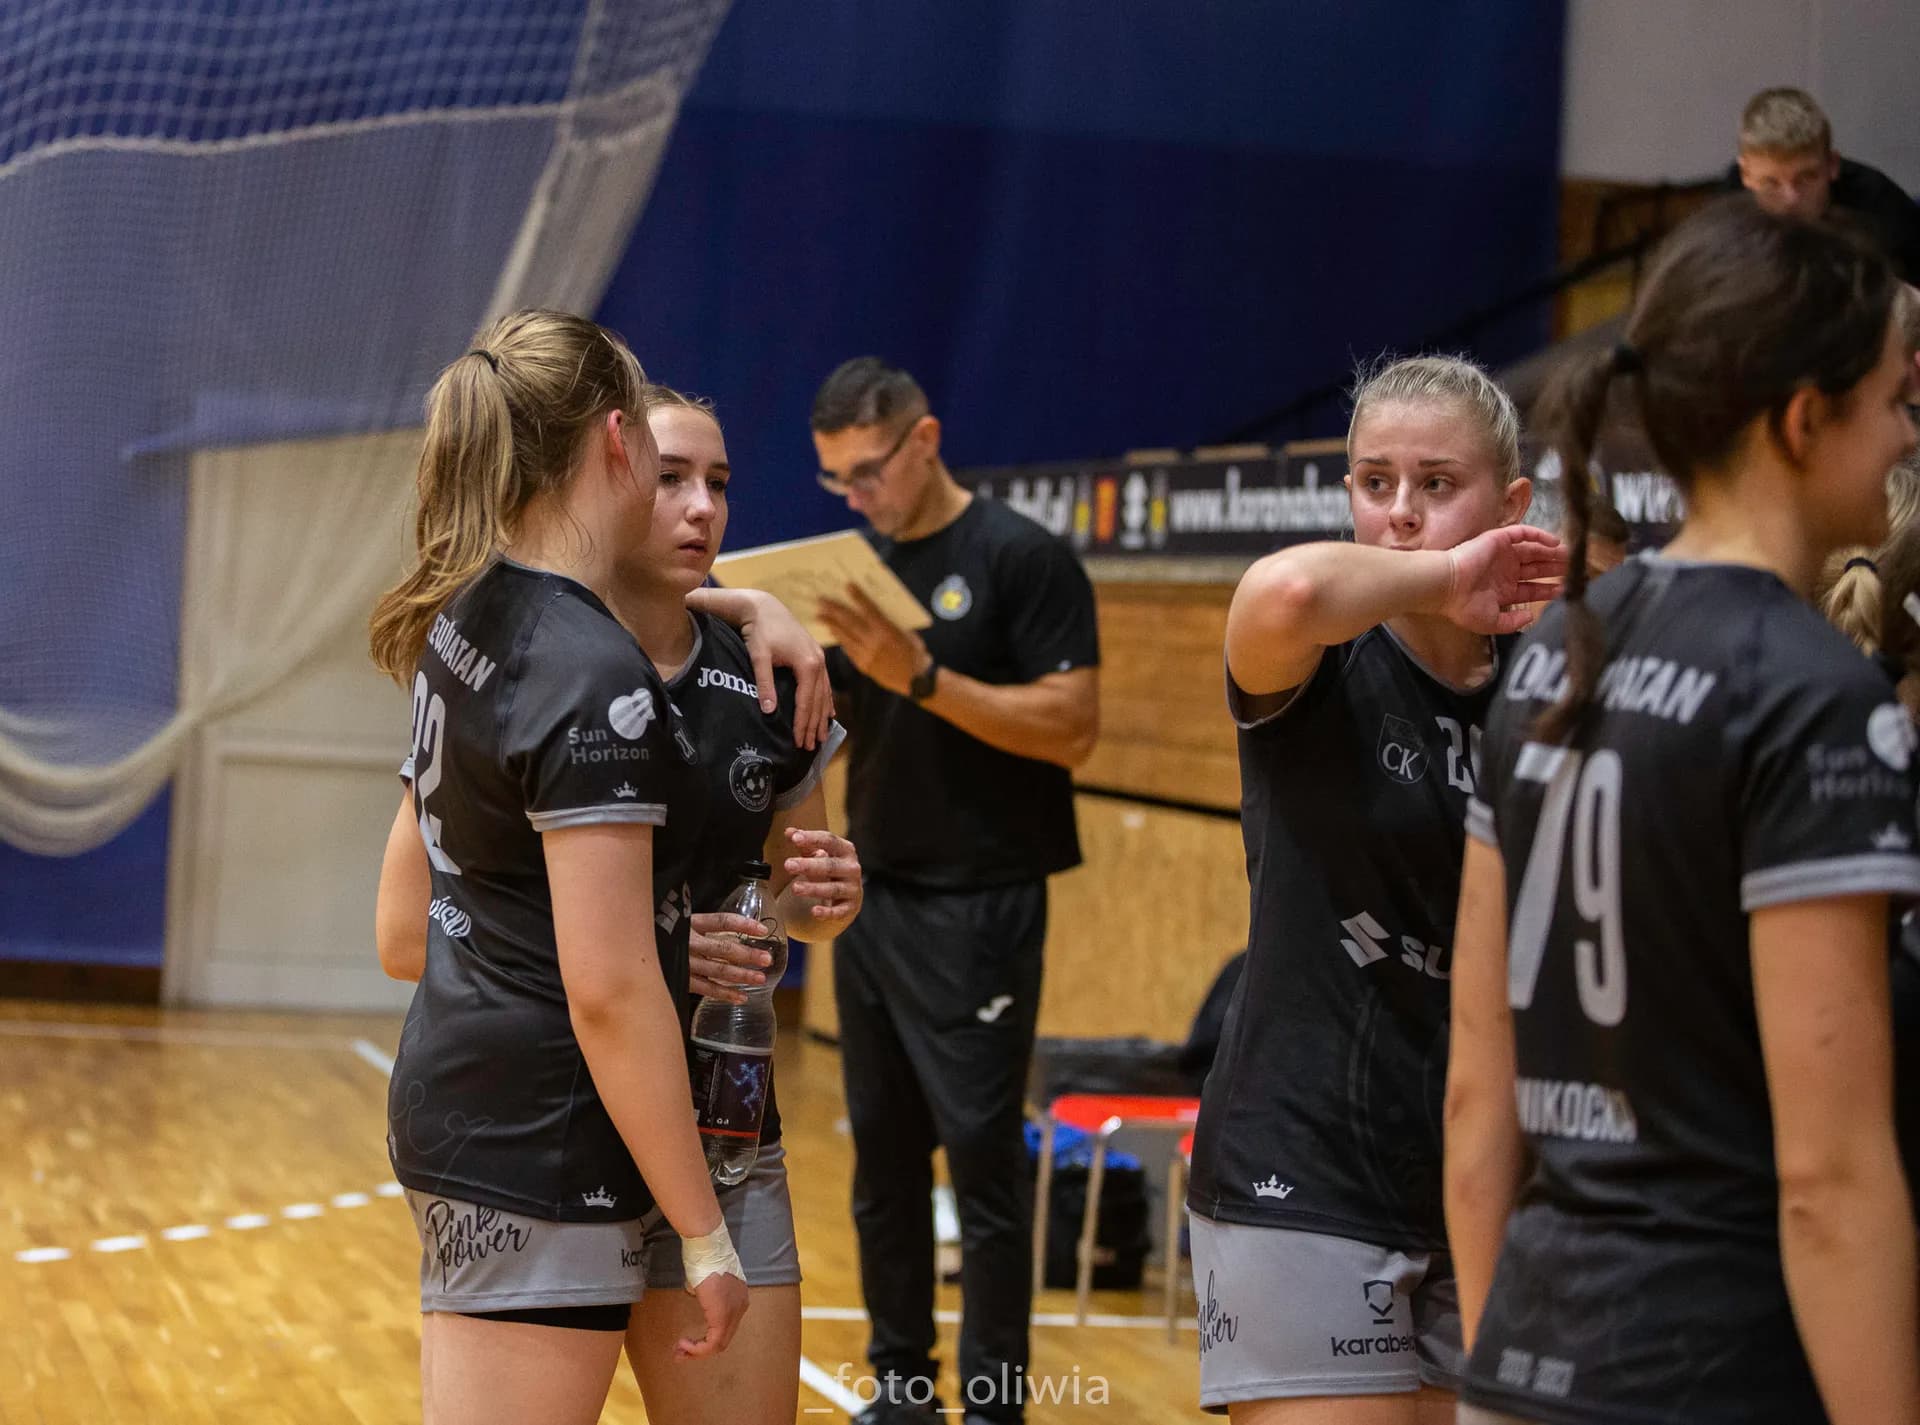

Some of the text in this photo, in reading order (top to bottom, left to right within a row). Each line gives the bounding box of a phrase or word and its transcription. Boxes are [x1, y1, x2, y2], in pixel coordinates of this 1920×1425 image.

[427, 611, 497, 692] EWIATAN
[568, 727, 608, 744] Sun
[570, 743, 650, 765] Horizon
[1382, 742, 1420, 780] CK
[1508, 741, 1628, 1027] 79
[1401, 935, 1451, 979] SU
[424, 1200, 501, 1260] Pink
[437, 1222, 532, 1293] power
[1330, 1332, 1417, 1357] karabe
